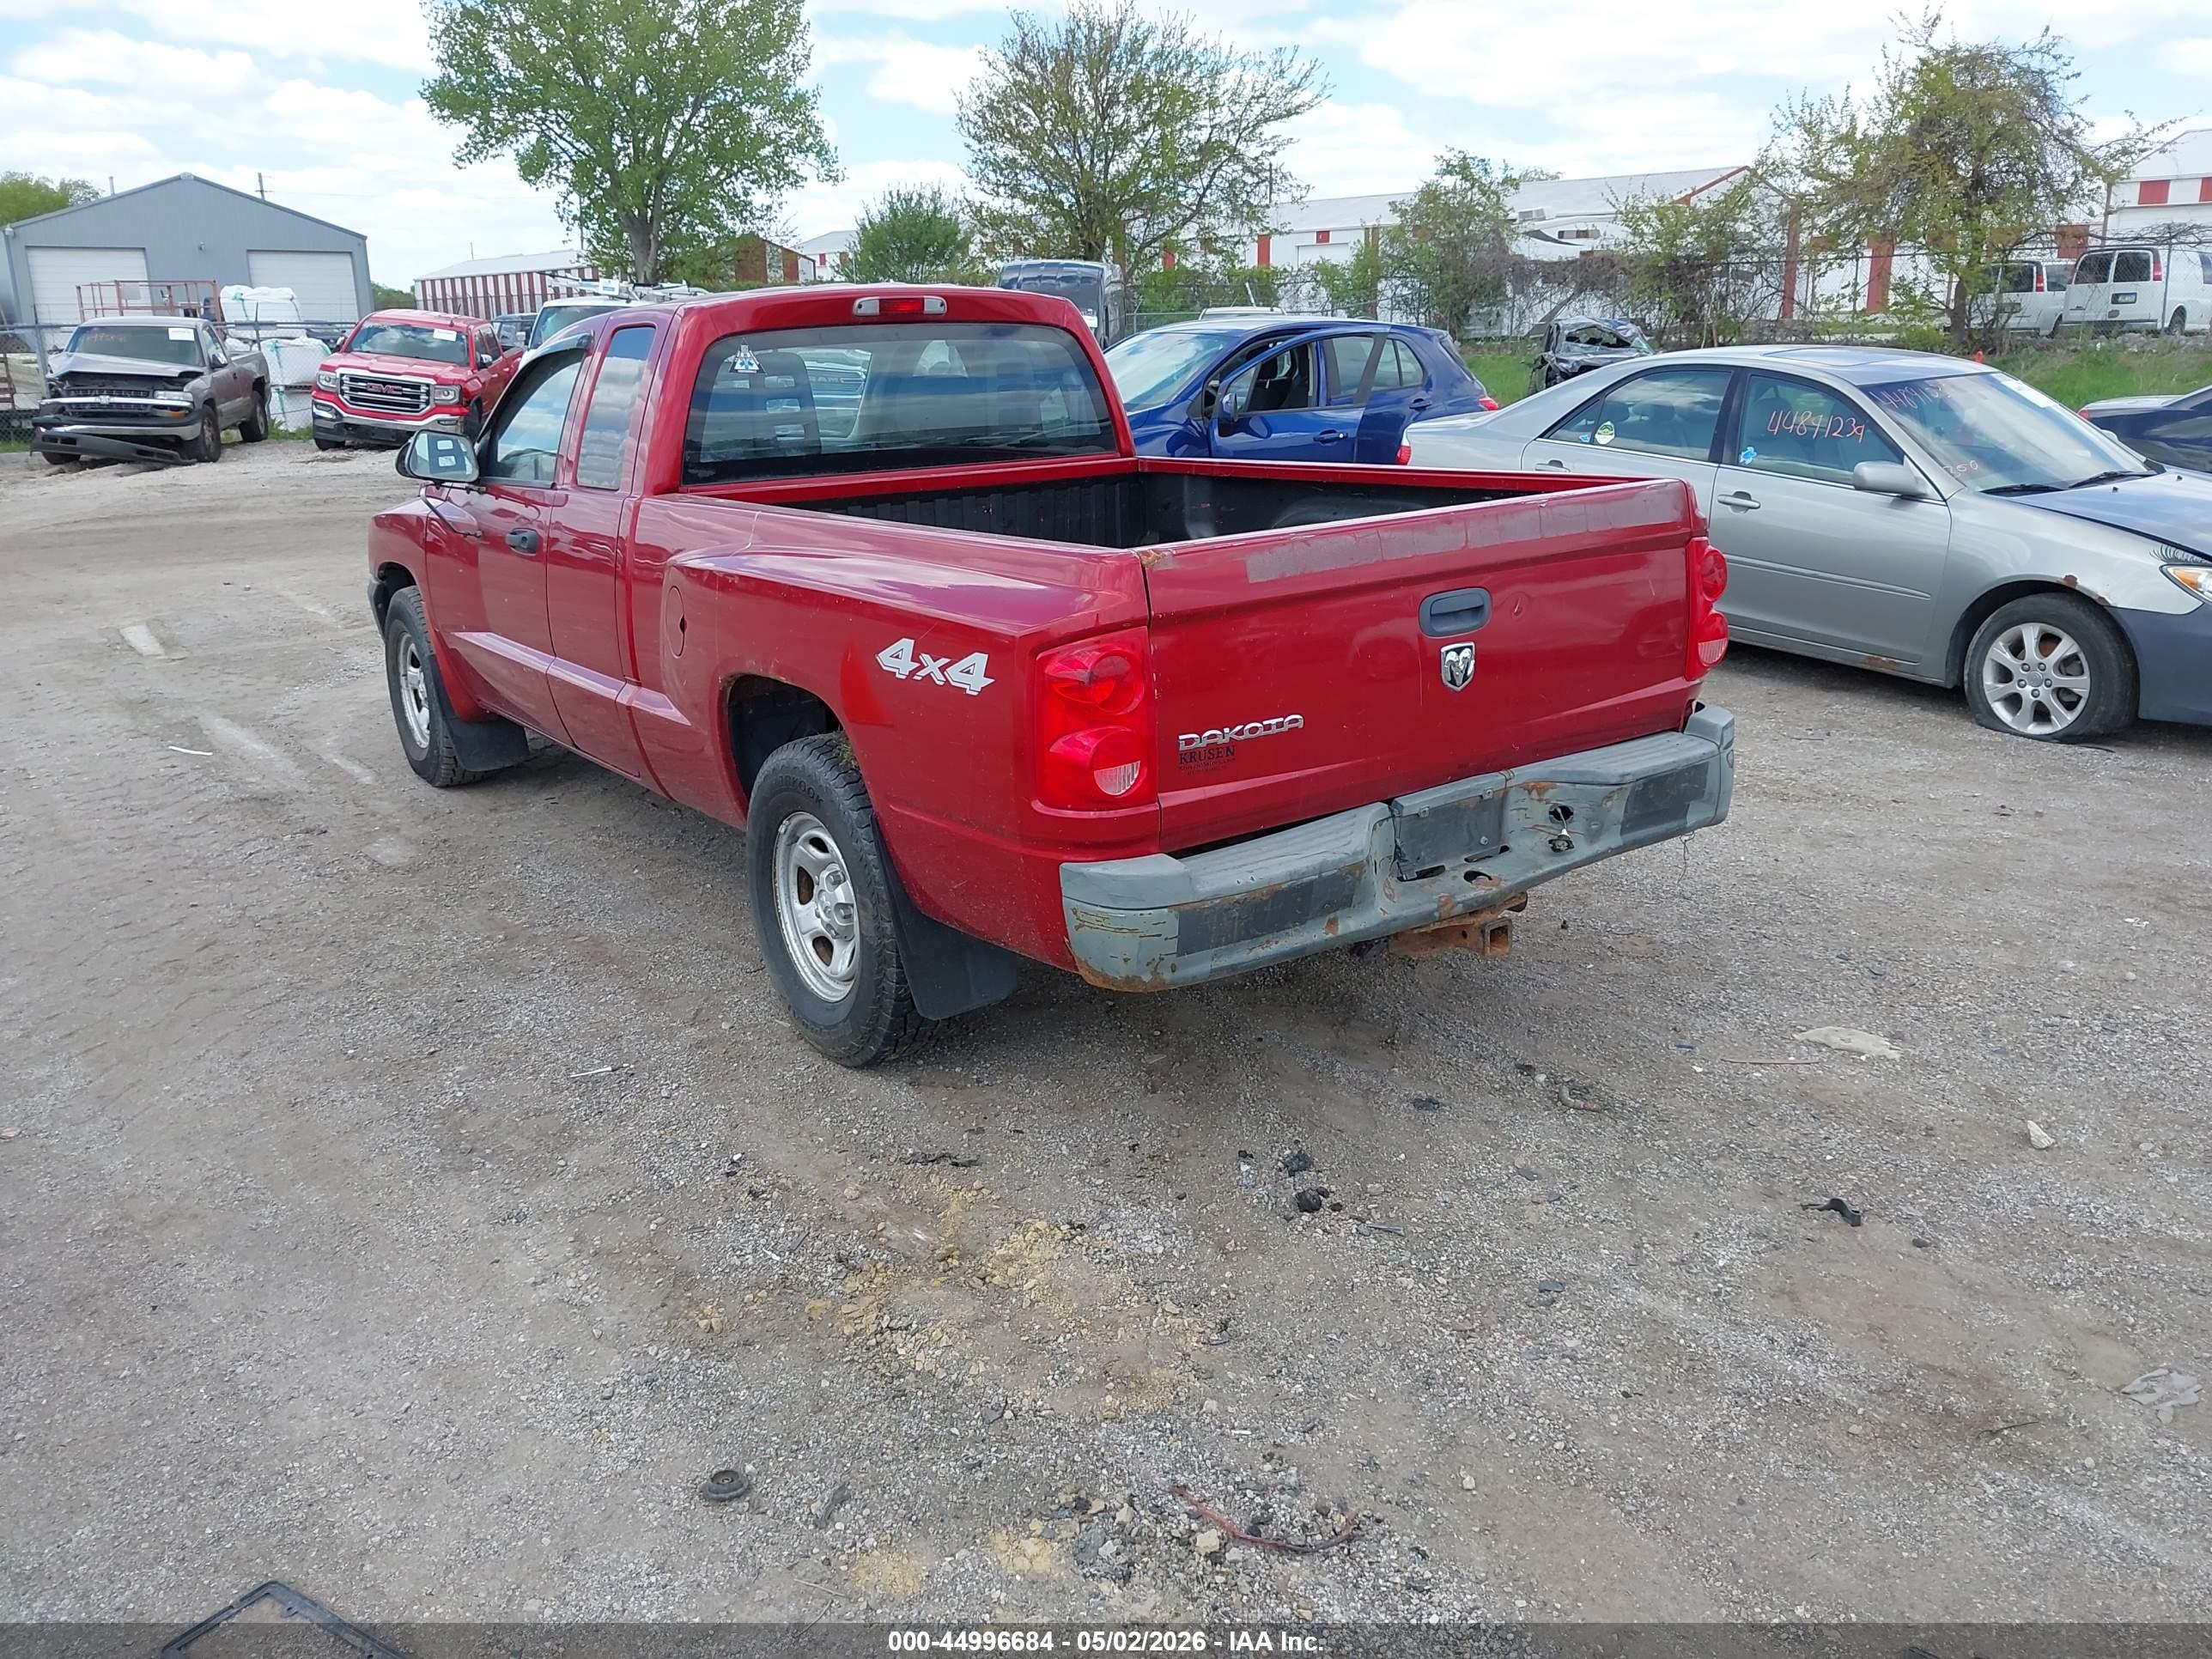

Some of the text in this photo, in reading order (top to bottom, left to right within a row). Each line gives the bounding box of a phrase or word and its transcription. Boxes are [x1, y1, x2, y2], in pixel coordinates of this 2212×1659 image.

[366, 382, 403, 395] GMC
[1767, 410, 1865, 444] 44891239
[875, 638, 995, 696] 4x4
[1178, 714, 1304, 751] DAKOTA
[1179, 744, 1236, 764] KRUSEN
